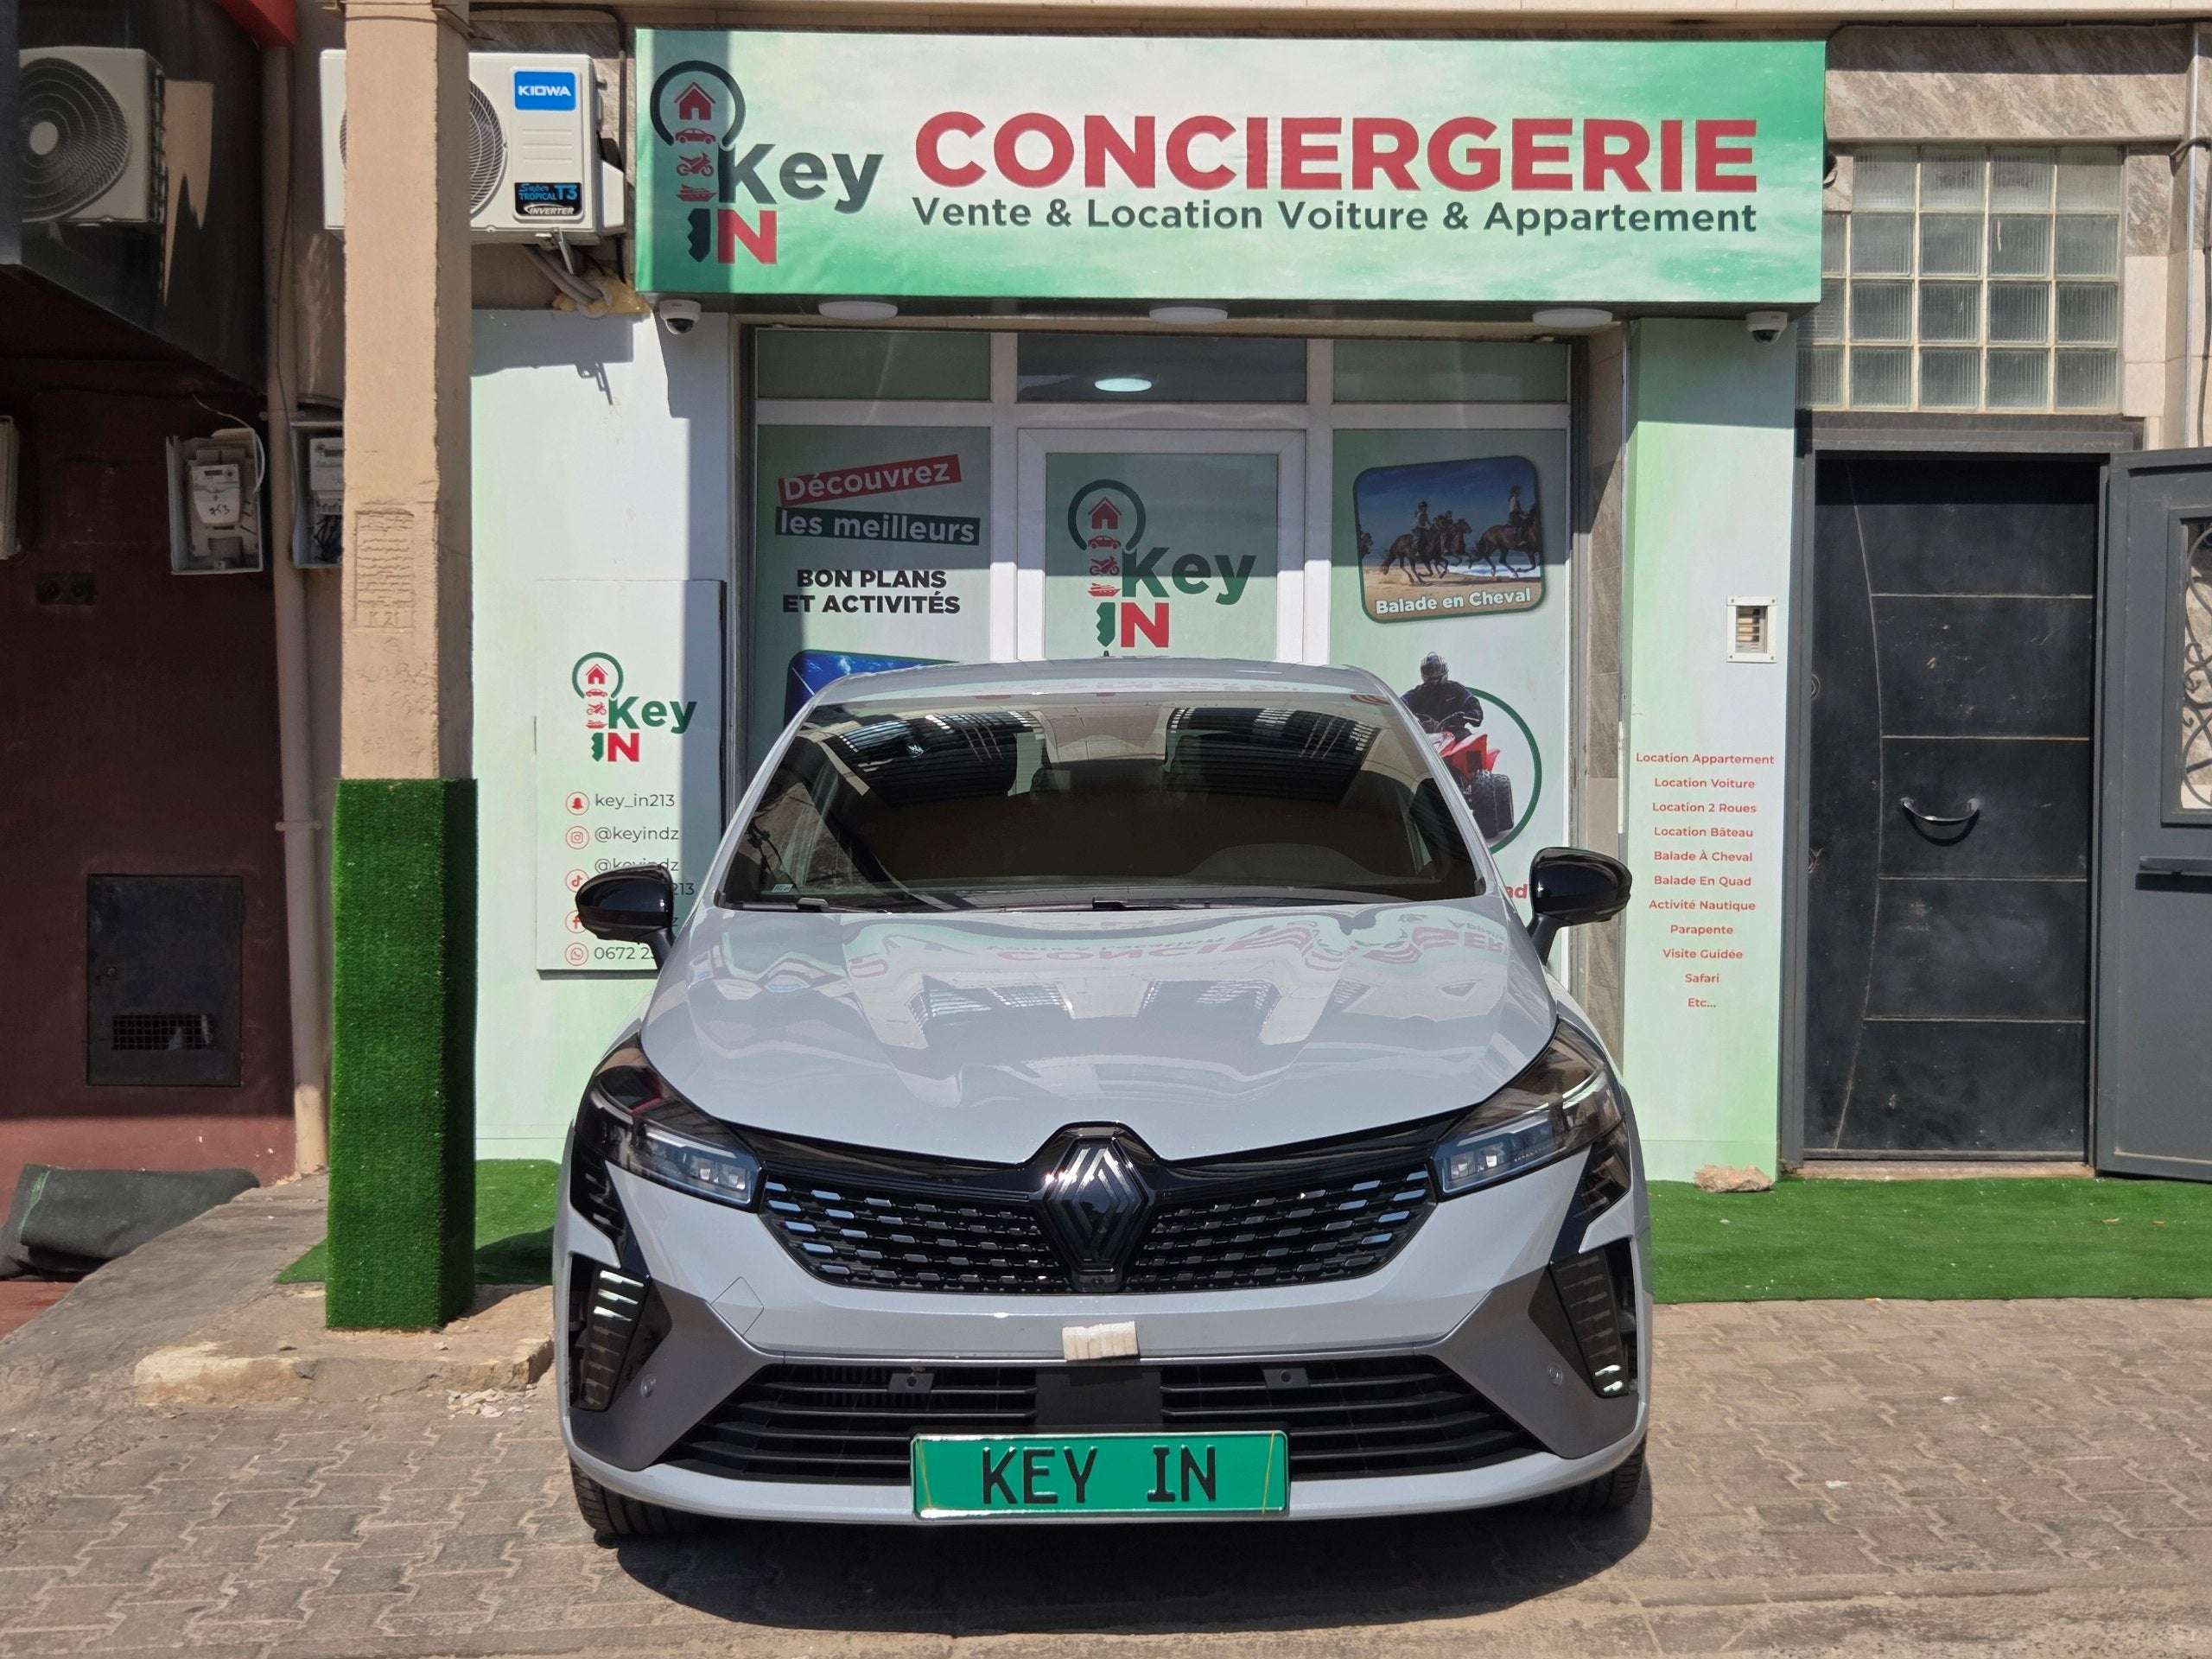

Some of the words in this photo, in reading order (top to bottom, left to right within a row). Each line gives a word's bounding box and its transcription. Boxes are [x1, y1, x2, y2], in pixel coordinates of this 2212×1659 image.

[518, 85, 571, 98] KIOWA
[915, 111, 1758, 193] CONCIERGERIE
[718, 143, 884, 214] Key
[518, 192, 557, 200] TROPICAL
[554, 184, 578, 200] T3
[530, 207, 575, 215] INVERTER
[912, 198, 1032, 227] Vente
[1046, 199, 1072, 228] &
[1088, 199, 1262, 229] Location
[1279, 200, 1428, 231] Voiture
[1443, 201, 1469, 230] &
[1484, 202, 1758, 237] Appartement
[688, 208, 778, 264] IN
[783, 462, 950, 500] Découvrez
[781, 510, 823, 534] les
[834, 513, 976, 543] meilleurs
[797, 569, 853, 588] BON
[860, 569, 947, 589] PLANS
[1122, 546, 1257, 606] Key
[783, 594, 816, 613] ET
[822, 591, 961, 614] ACTIVITÉS
[1375, 596, 1438, 614] Balade
[1443, 594, 1465, 608] en
[1469, 588, 1532, 606] Cheval
[1096, 601, 1170, 648] IN
[608, 696, 698, 734] Key
[591, 732, 640, 762] IN
[1636, 753, 1688, 763] Location
[1692, 753, 1775, 766] Appartement
[1655, 778, 1707, 788] Location
[1711, 779, 1756, 789] Voiture
[595, 793, 676, 810] key_in213
[1652, 802, 1705, 812] Location
[1708, 804, 1715, 812] 2
[1719, 804, 1757, 813] Roues
[594, 827, 680, 843] @keyindz
[1654, 826, 1707, 836] Location
[1654, 850, 1695, 861] Balade
[1699, 849, 1708, 861] À
[1712, 851, 1752, 861] Cheval
[1654, 875, 1695, 886] Balade
[1700, 875, 1715, 886] En
[1719, 876, 1751, 887] Quad
[1649, 899, 1695, 909] Activité
[1700, 900, 1757, 912] Nautique
[1670, 925, 1734, 936] Parapente
[594, 946, 635, 960] 0672
[1662, 949, 1697, 958] Visite
[1700, 949, 1743, 959] Guidée
[1685, 973, 1719, 983] Safari
[1688, 998, 1716, 1008] Etc...
[982, 1445, 1098, 1505] KEY
[1146, 1443, 1217, 1503] IN
